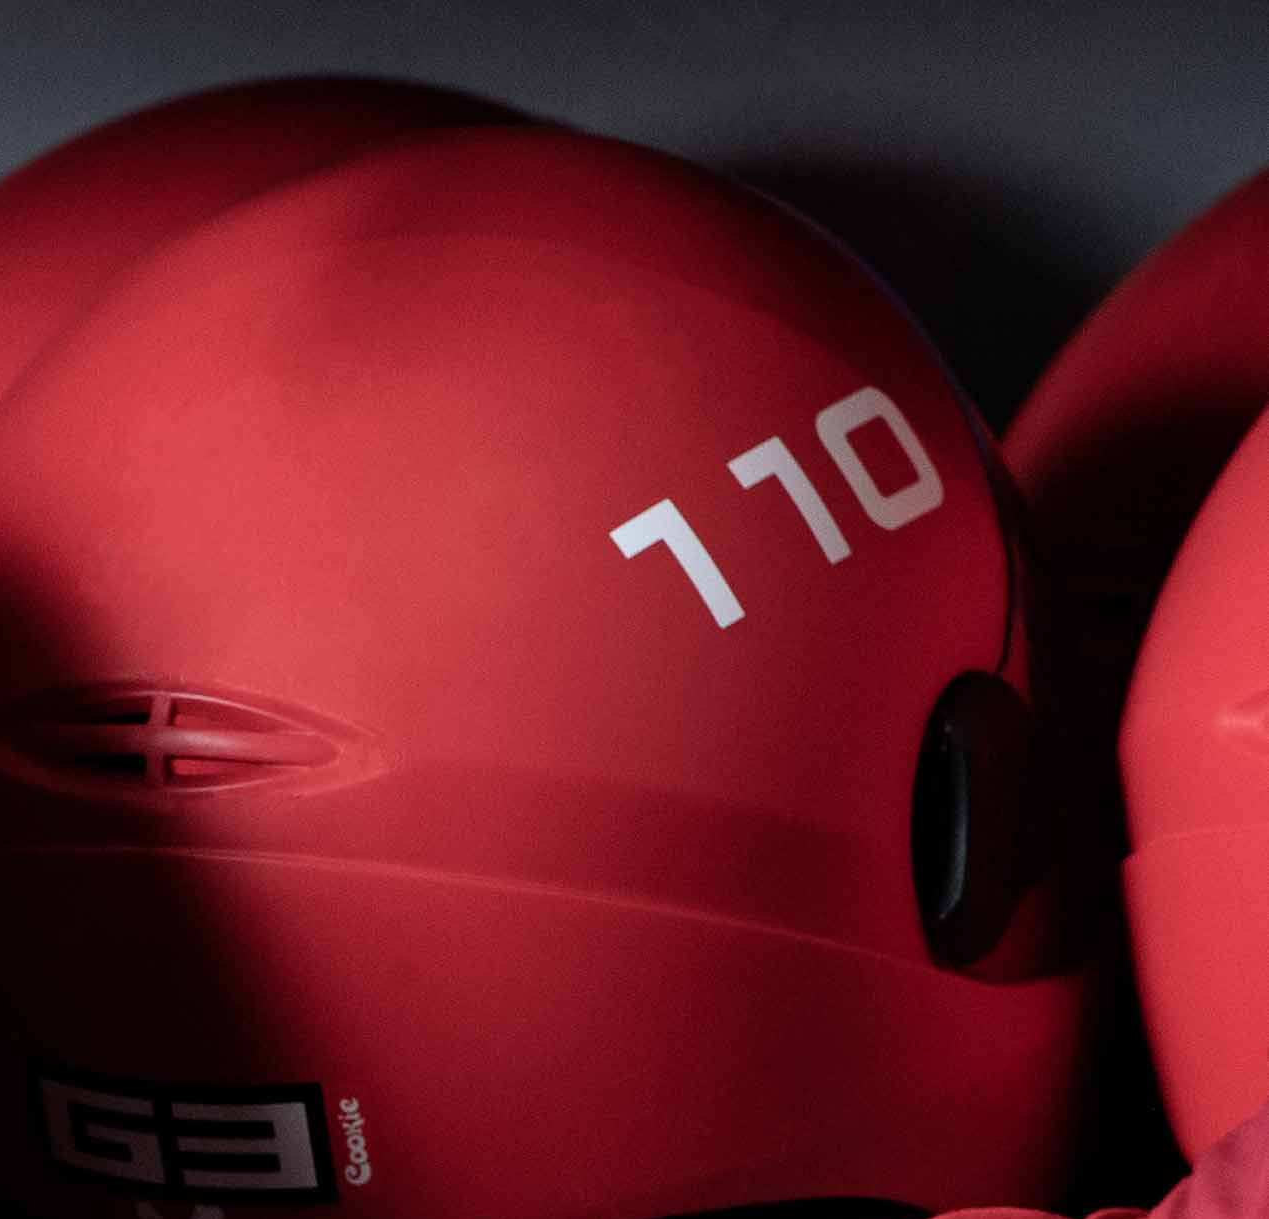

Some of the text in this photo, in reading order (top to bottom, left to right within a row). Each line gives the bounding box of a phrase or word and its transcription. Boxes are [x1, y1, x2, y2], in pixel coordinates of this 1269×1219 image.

[609, 386, 944, 629] 110
[39, 1075, 318, 1188] G3
[338, 1097, 372, 1186] Cookie
